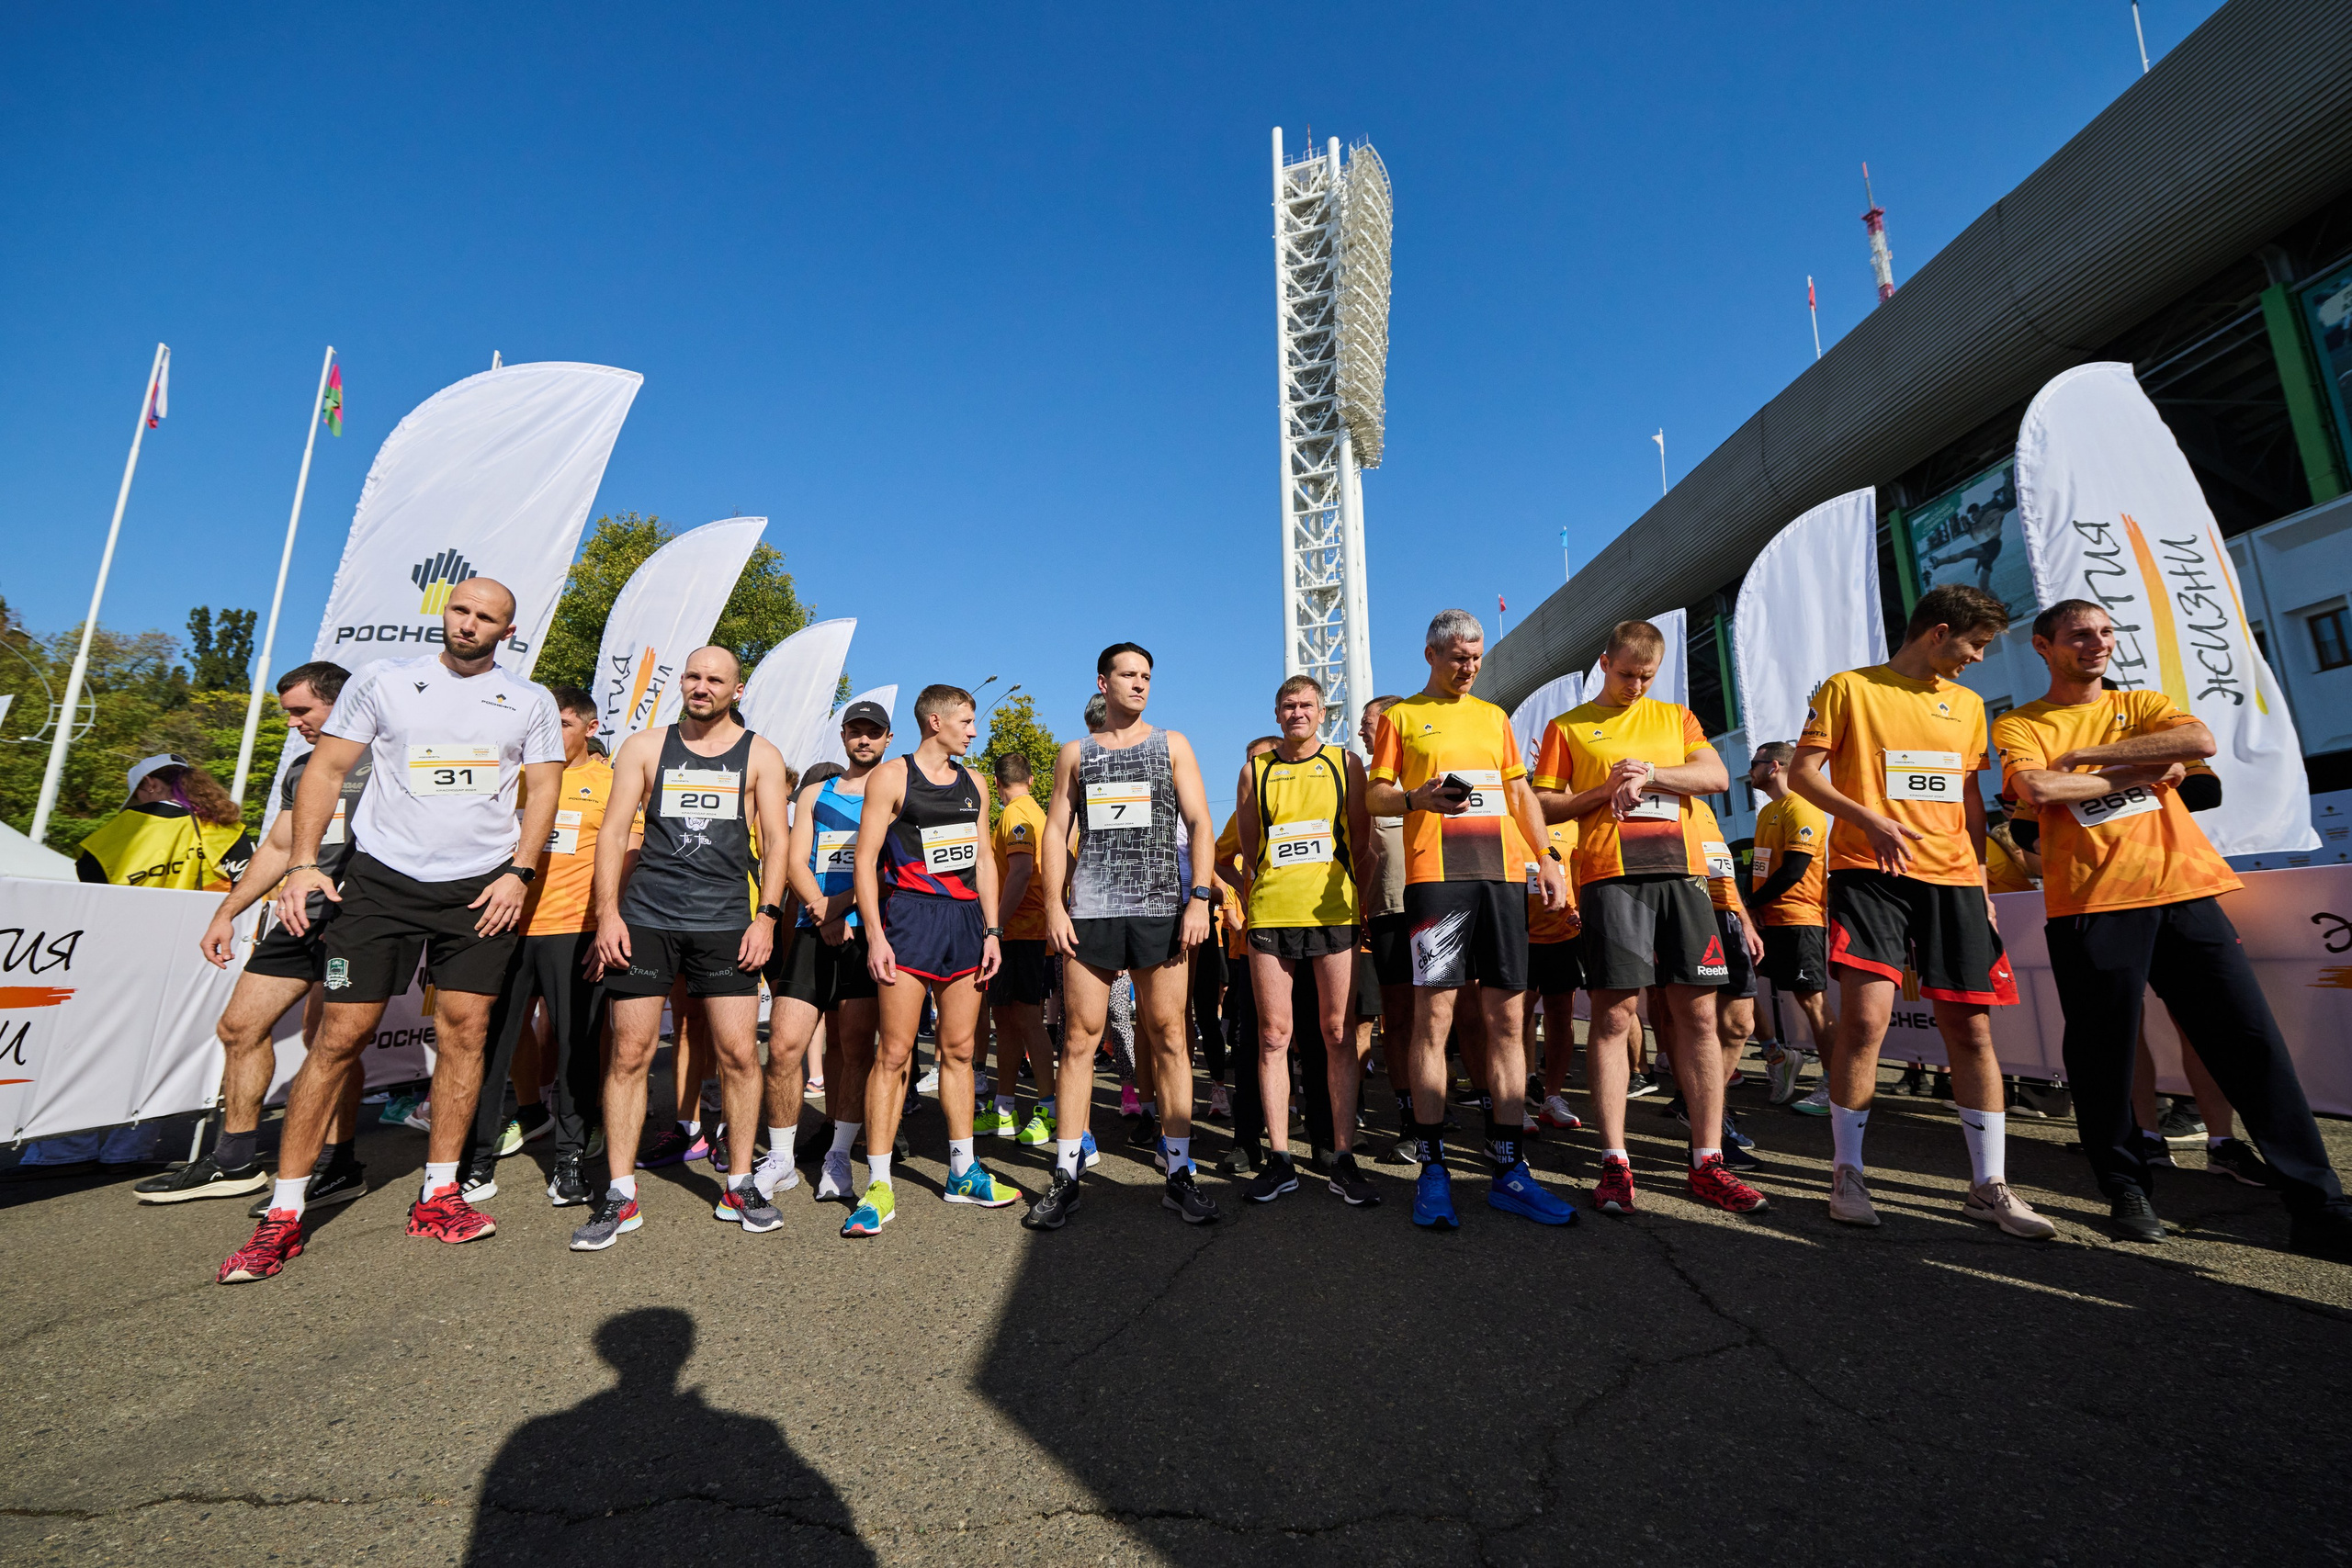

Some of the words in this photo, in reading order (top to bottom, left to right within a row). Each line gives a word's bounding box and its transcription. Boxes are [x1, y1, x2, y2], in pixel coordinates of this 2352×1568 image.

[2159, 534, 2245, 705] ЖИЗНИ
[335, 625, 529, 654] РОСНЕЬ
[434, 769, 472, 785] 31
[1908, 775, 1946, 792] 86
[680, 794, 720, 809] 20
[2080, 787, 2146, 816] 268
[1111, 805, 1126, 820] 7
[829, 852, 854, 863] 43
[933, 845, 973, 863] 258
[1278, 840, 1320, 858] 251
[1753, 861, 1766, 871] 66
[633, 968, 656, 976] TRAIN
[314, 1176, 346, 1195] HEAD
